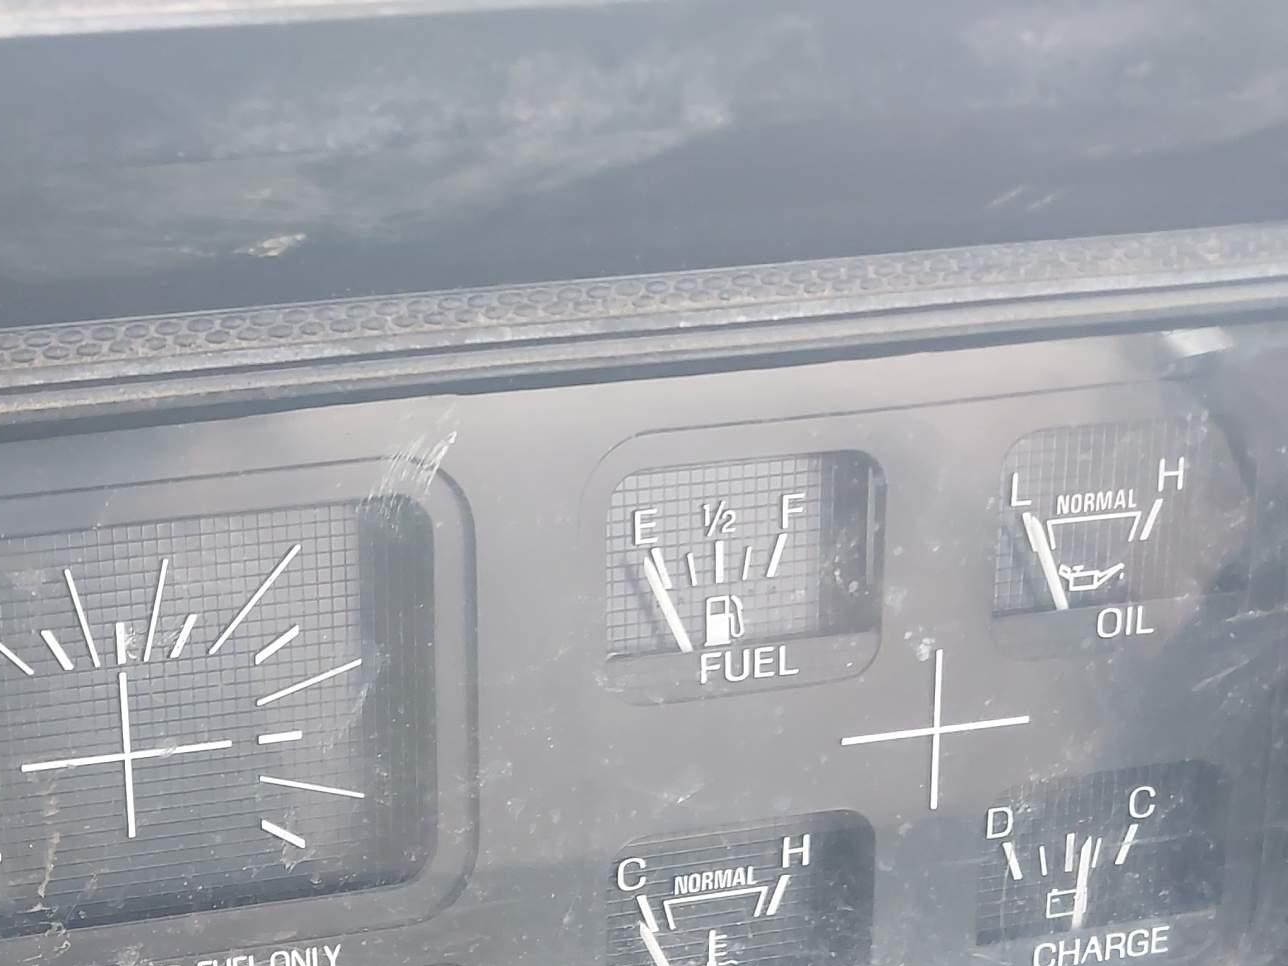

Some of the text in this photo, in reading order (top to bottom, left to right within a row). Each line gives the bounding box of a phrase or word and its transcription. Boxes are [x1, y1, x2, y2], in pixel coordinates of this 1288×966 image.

[1011, 472, 1032, 506] L
[1158, 456, 1185, 492] H
[1056, 488, 1137, 515] NORMAL
[634, 508, 659, 545] E
[782, 493, 807, 529] F
[1096, 605, 1155, 639] OIL
[699, 645, 800, 685] FUEL
[1128, 786, 1157, 818] C
[985, 806, 1014, 840] D
[781, 834, 811, 868] H
[617, 857, 647, 891] C
[673, 866, 759, 896] NORMAL
